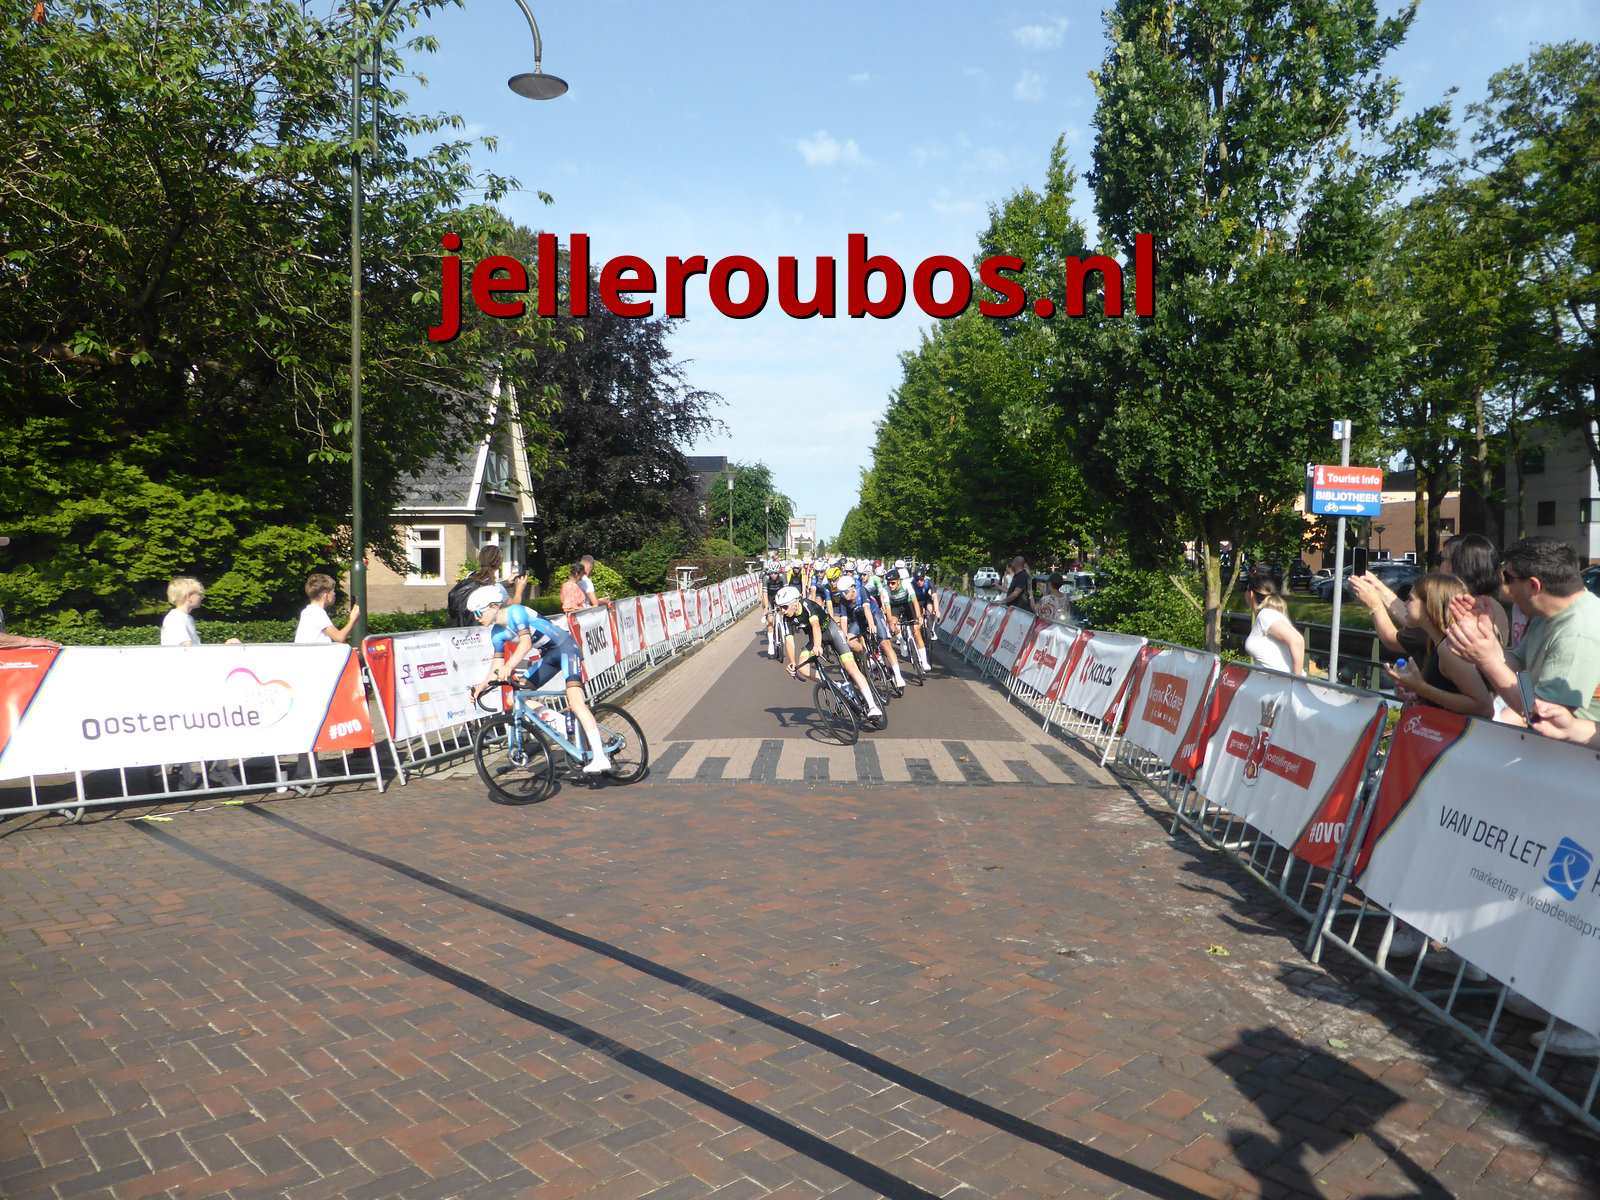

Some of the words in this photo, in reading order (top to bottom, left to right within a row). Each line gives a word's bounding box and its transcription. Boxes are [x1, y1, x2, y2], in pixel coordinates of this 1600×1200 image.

[1327, 473, 1360, 484] Tourist
[1362, 474, 1381, 485] Info
[1315, 490, 1379, 503] BIBLIOTHEEK
[328, 718, 362, 740] #OVO
[1439, 805, 1473, 837] VAN
[1472, 820, 1508, 853] DER
[1509, 835, 1547, 868] LET
[1469, 866, 1518, 902] marketing
